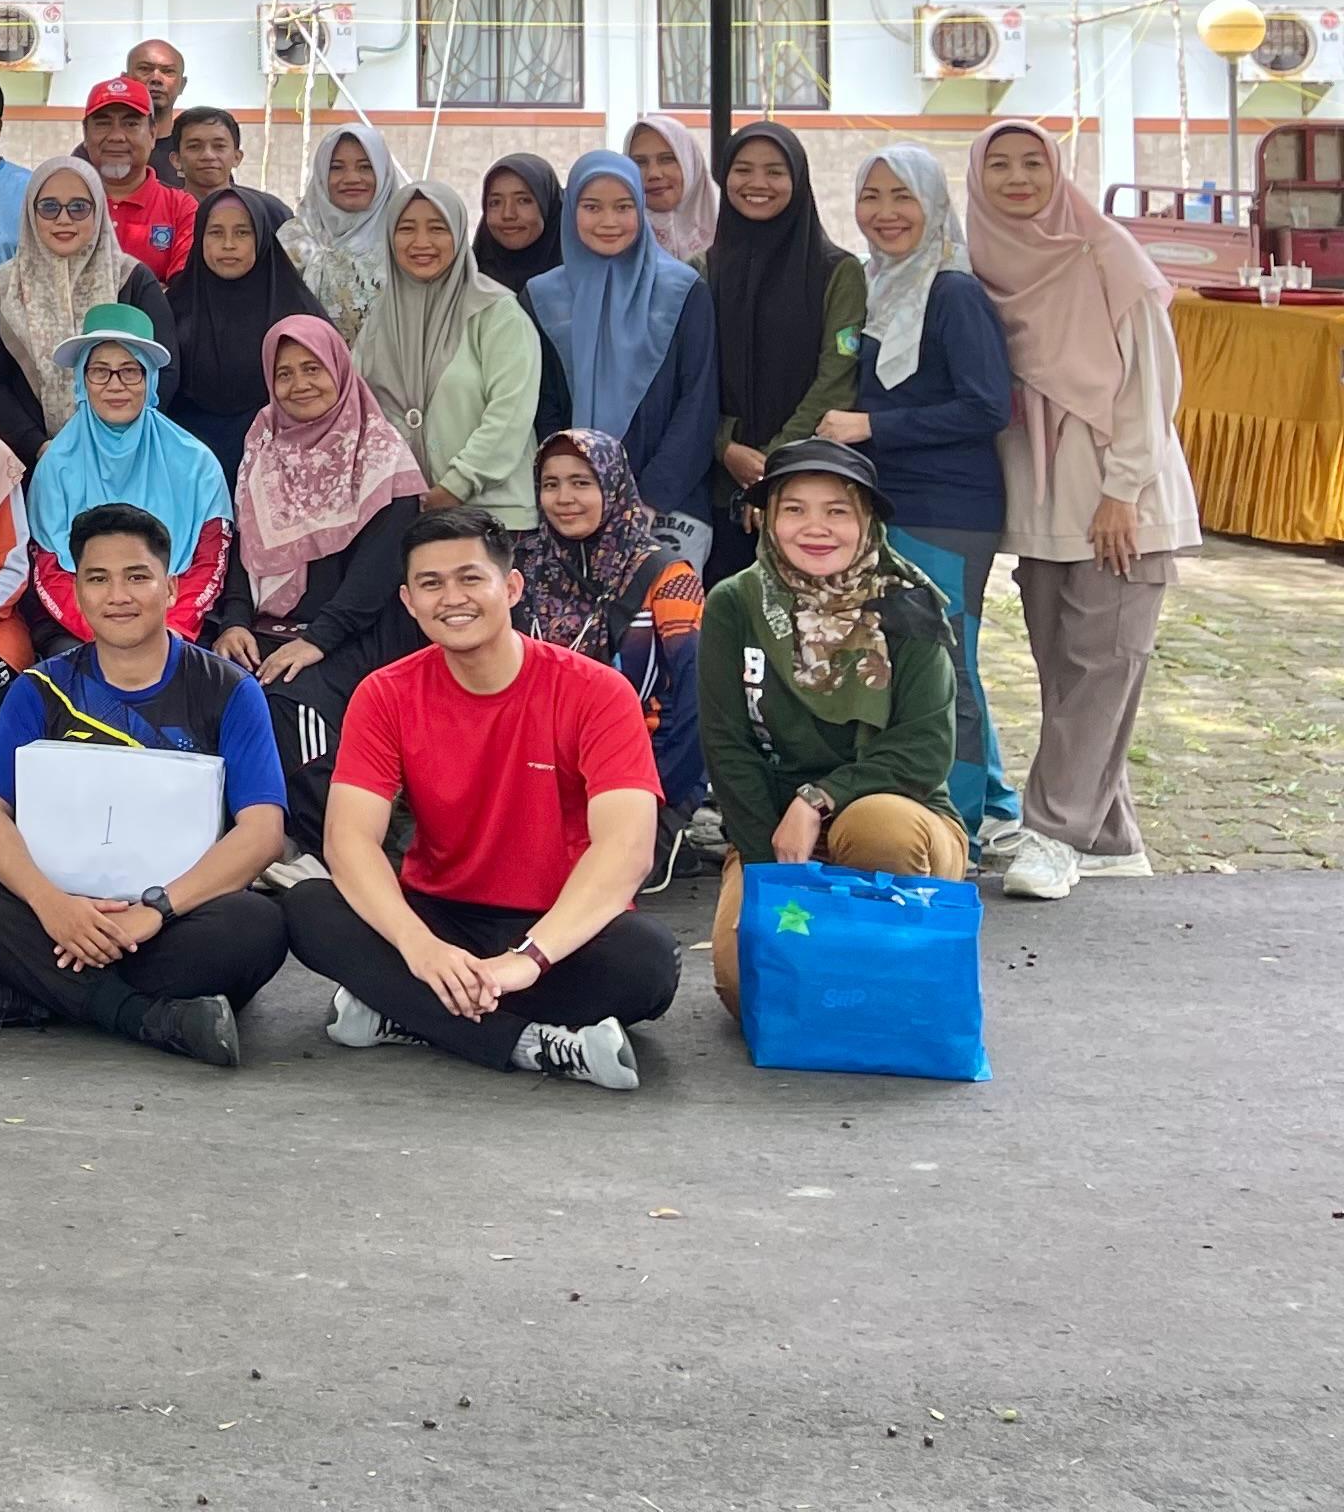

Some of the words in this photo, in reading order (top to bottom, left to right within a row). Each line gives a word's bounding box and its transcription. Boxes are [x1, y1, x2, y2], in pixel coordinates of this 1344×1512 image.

[44, 25, 60, 34] LG
[336, 27, 352, 36] LG
[1004, 31, 1021, 41] LG
[1322, 31, 1339, 42] LG
